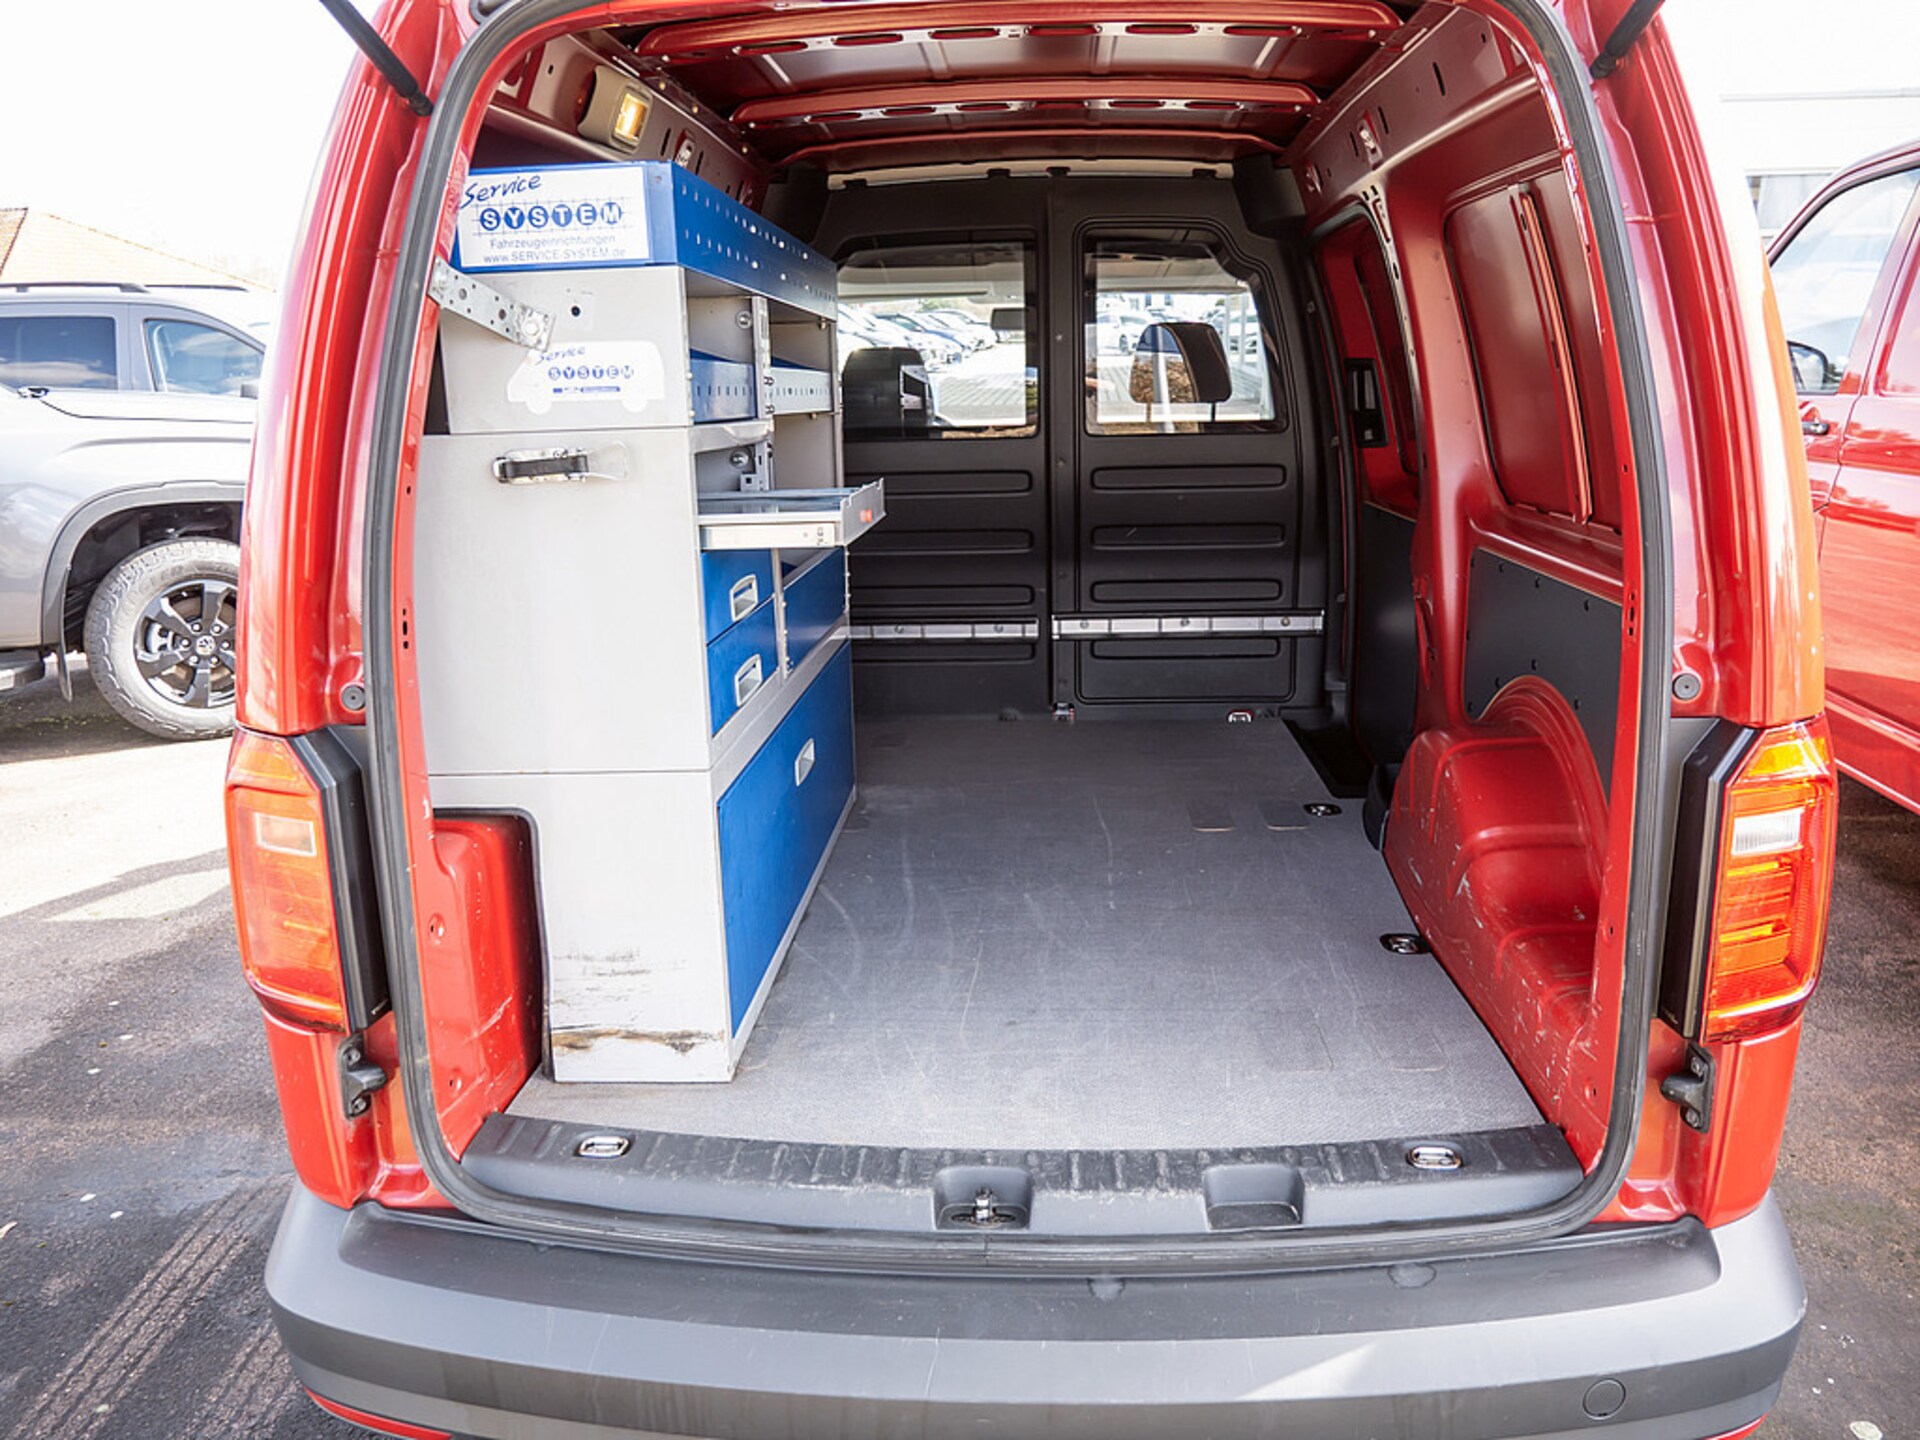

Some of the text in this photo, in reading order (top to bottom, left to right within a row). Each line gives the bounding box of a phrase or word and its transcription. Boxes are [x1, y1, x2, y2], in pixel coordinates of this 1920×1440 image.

[460, 175, 542, 210] Service
[479, 202, 622, 231] SYSTEM
[489, 235, 616, 250] Fahrzeugeinrichtungen
[548, 365, 635, 381] SYSTEM
